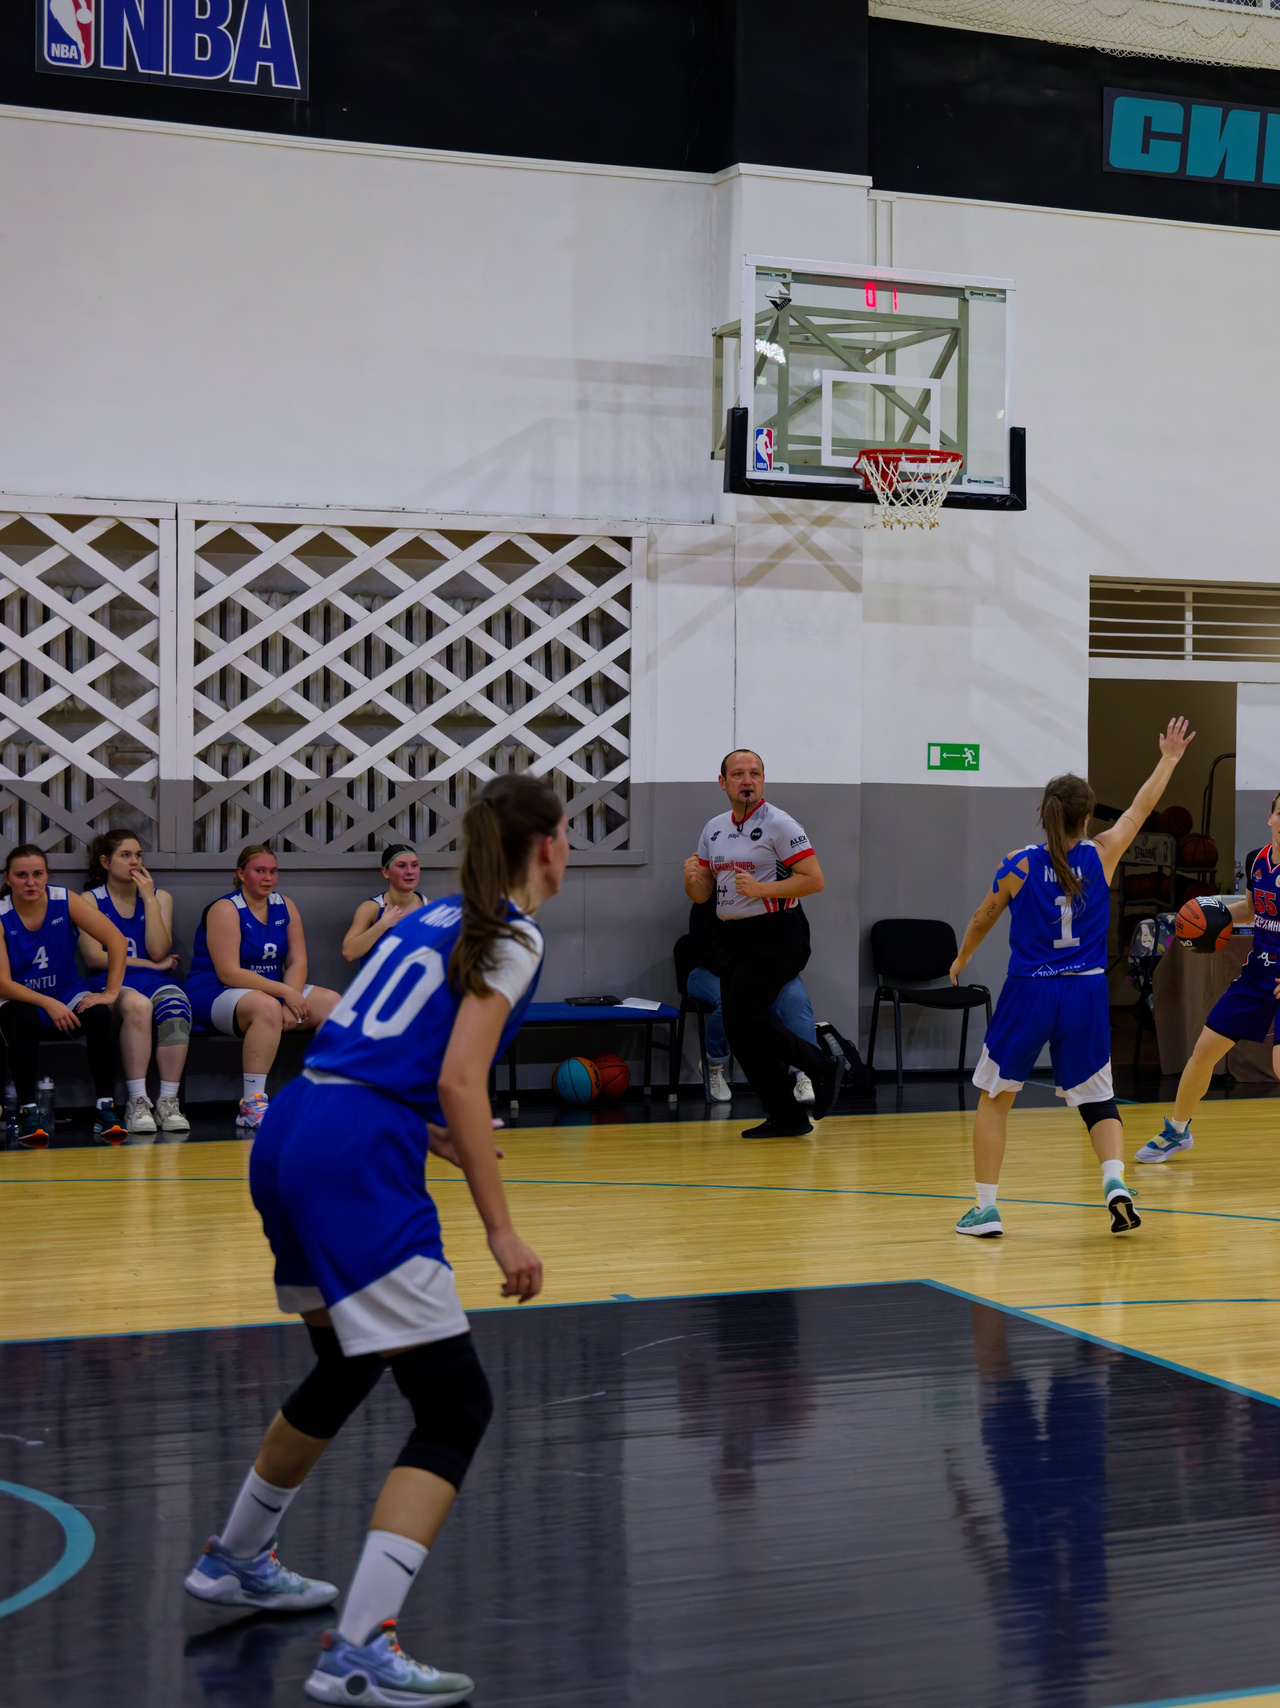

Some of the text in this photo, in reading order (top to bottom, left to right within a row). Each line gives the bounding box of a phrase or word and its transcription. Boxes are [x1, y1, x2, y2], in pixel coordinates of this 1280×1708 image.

[51, 43, 78, 60] NBA
[101, 0, 301, 89] NBA
[1254, 888, 1278, 916] 55
[1053, 896, 1080, 949] 1
[32, 946, 49, 969] 4
[262, 943, 277, 960] 8
[328, 935, 446, 1041] 10
